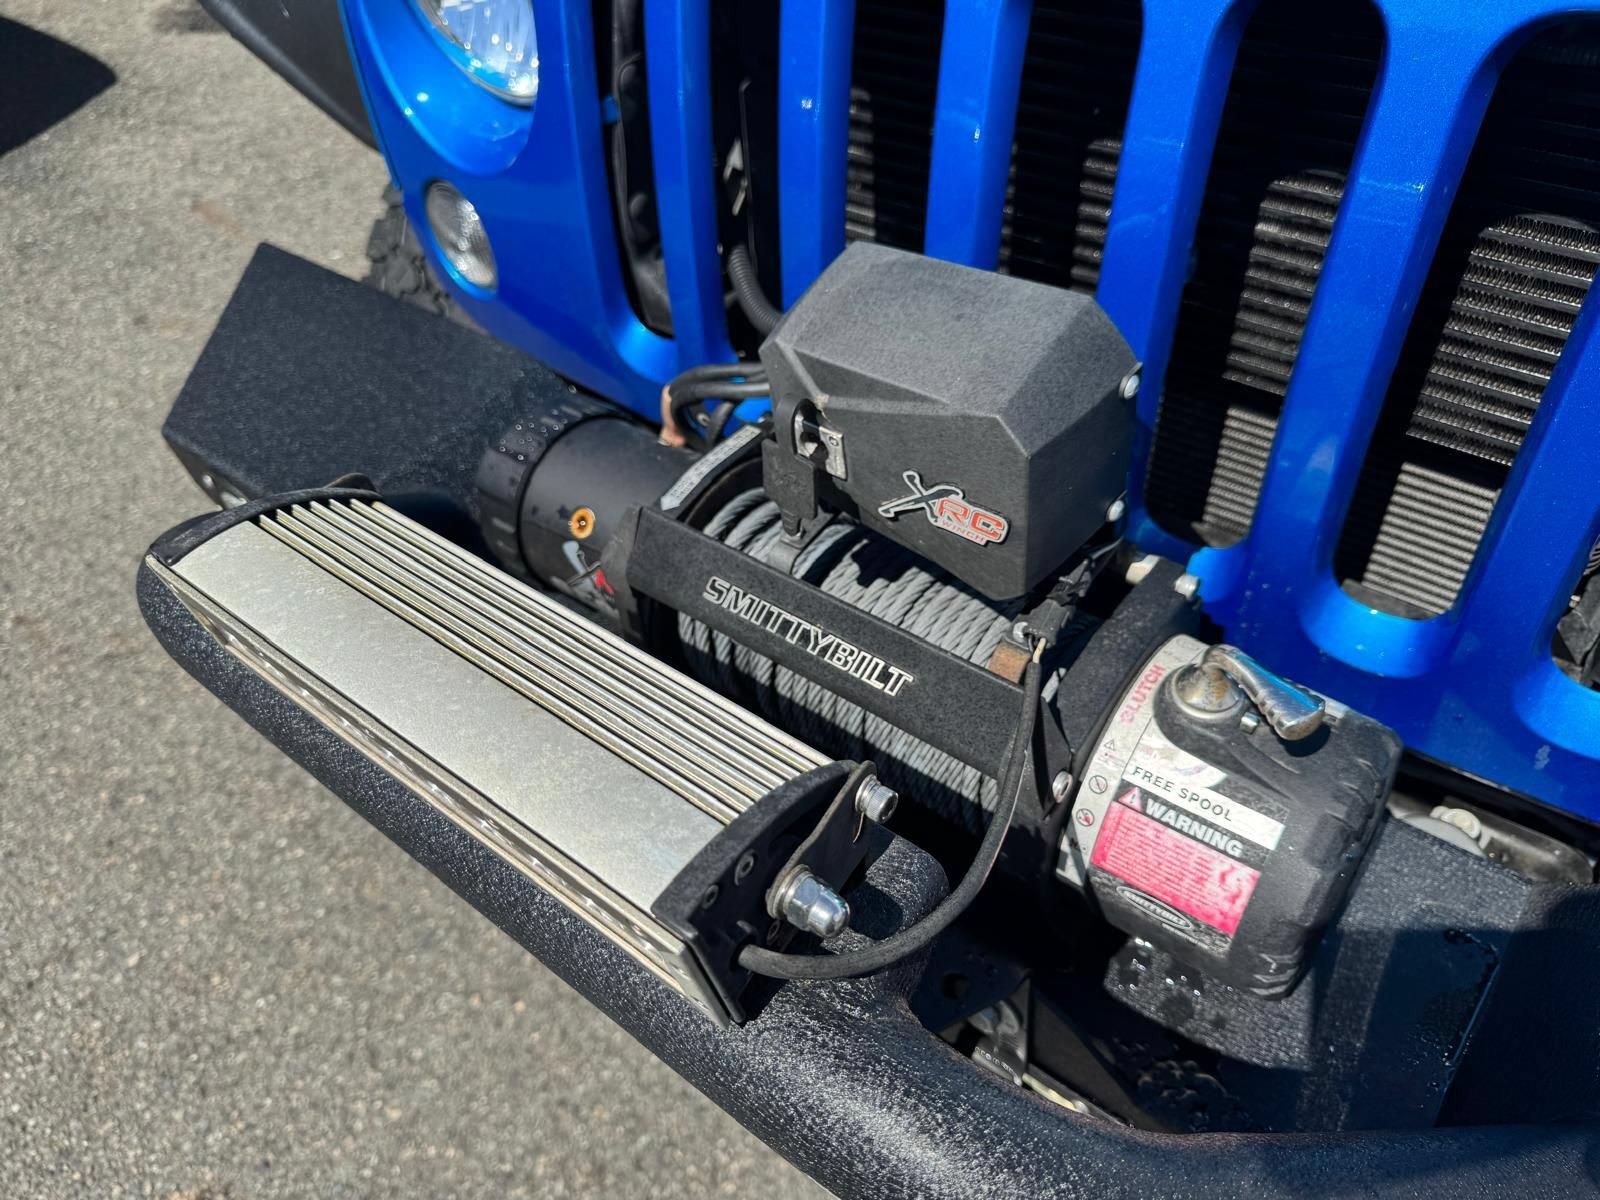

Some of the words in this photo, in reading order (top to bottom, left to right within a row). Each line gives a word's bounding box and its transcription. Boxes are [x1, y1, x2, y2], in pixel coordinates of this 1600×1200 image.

[941, 520, 985, 544] WINCH
[702, 576, 914, 696] SMITTYBILT
[1120, 664, 1167, 724] CLUTCH
[1132, 766, 1175, 793] FREE
[1178, 787, 1232, 822] SPOOL
[1145, 798, 1244, 858] WARNING
